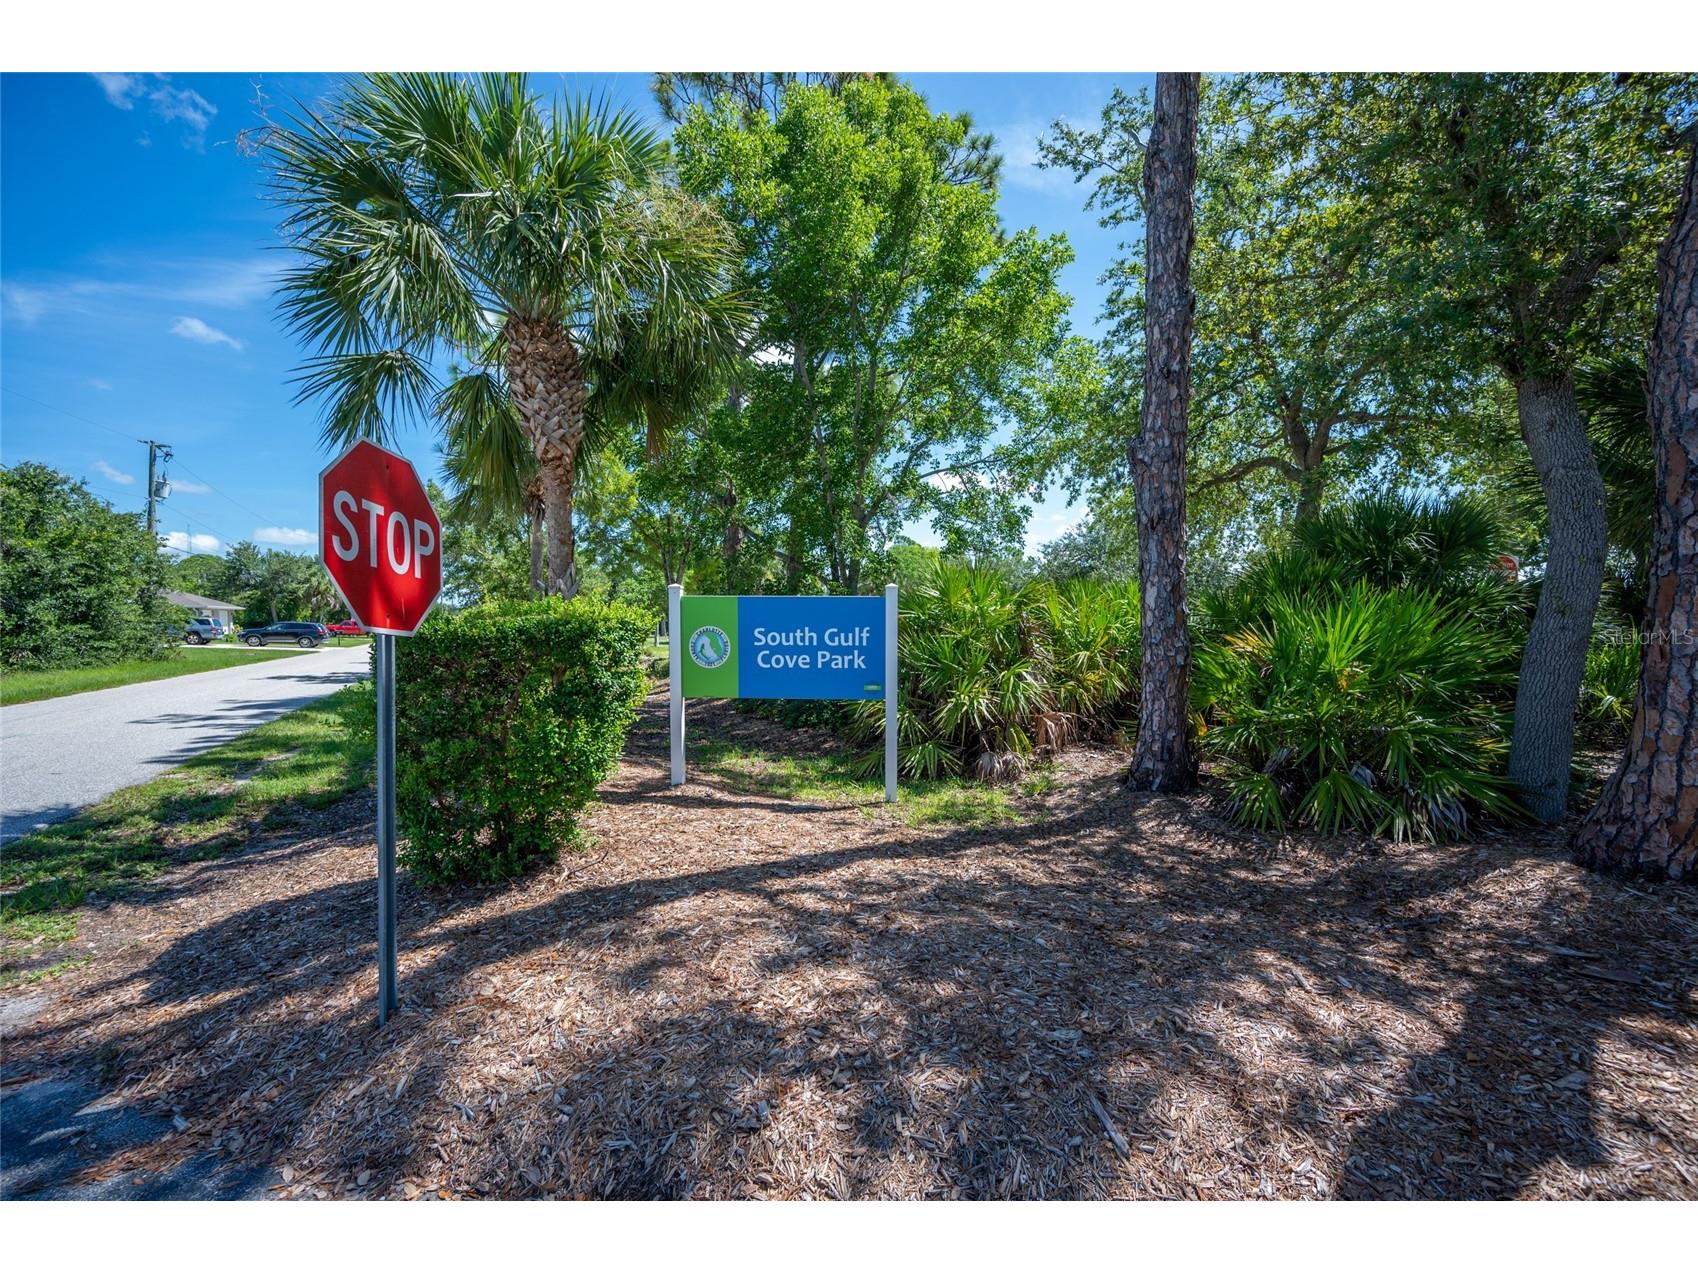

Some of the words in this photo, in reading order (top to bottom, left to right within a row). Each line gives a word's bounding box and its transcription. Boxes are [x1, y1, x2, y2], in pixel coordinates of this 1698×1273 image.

[332, 490, 435, 579] STOP
[754, 627, 817, 646] South
[824, 627, 870, 646] Gulf
[757, 650, 810, 669] Cove
[817, 650, 866, 669] Park
